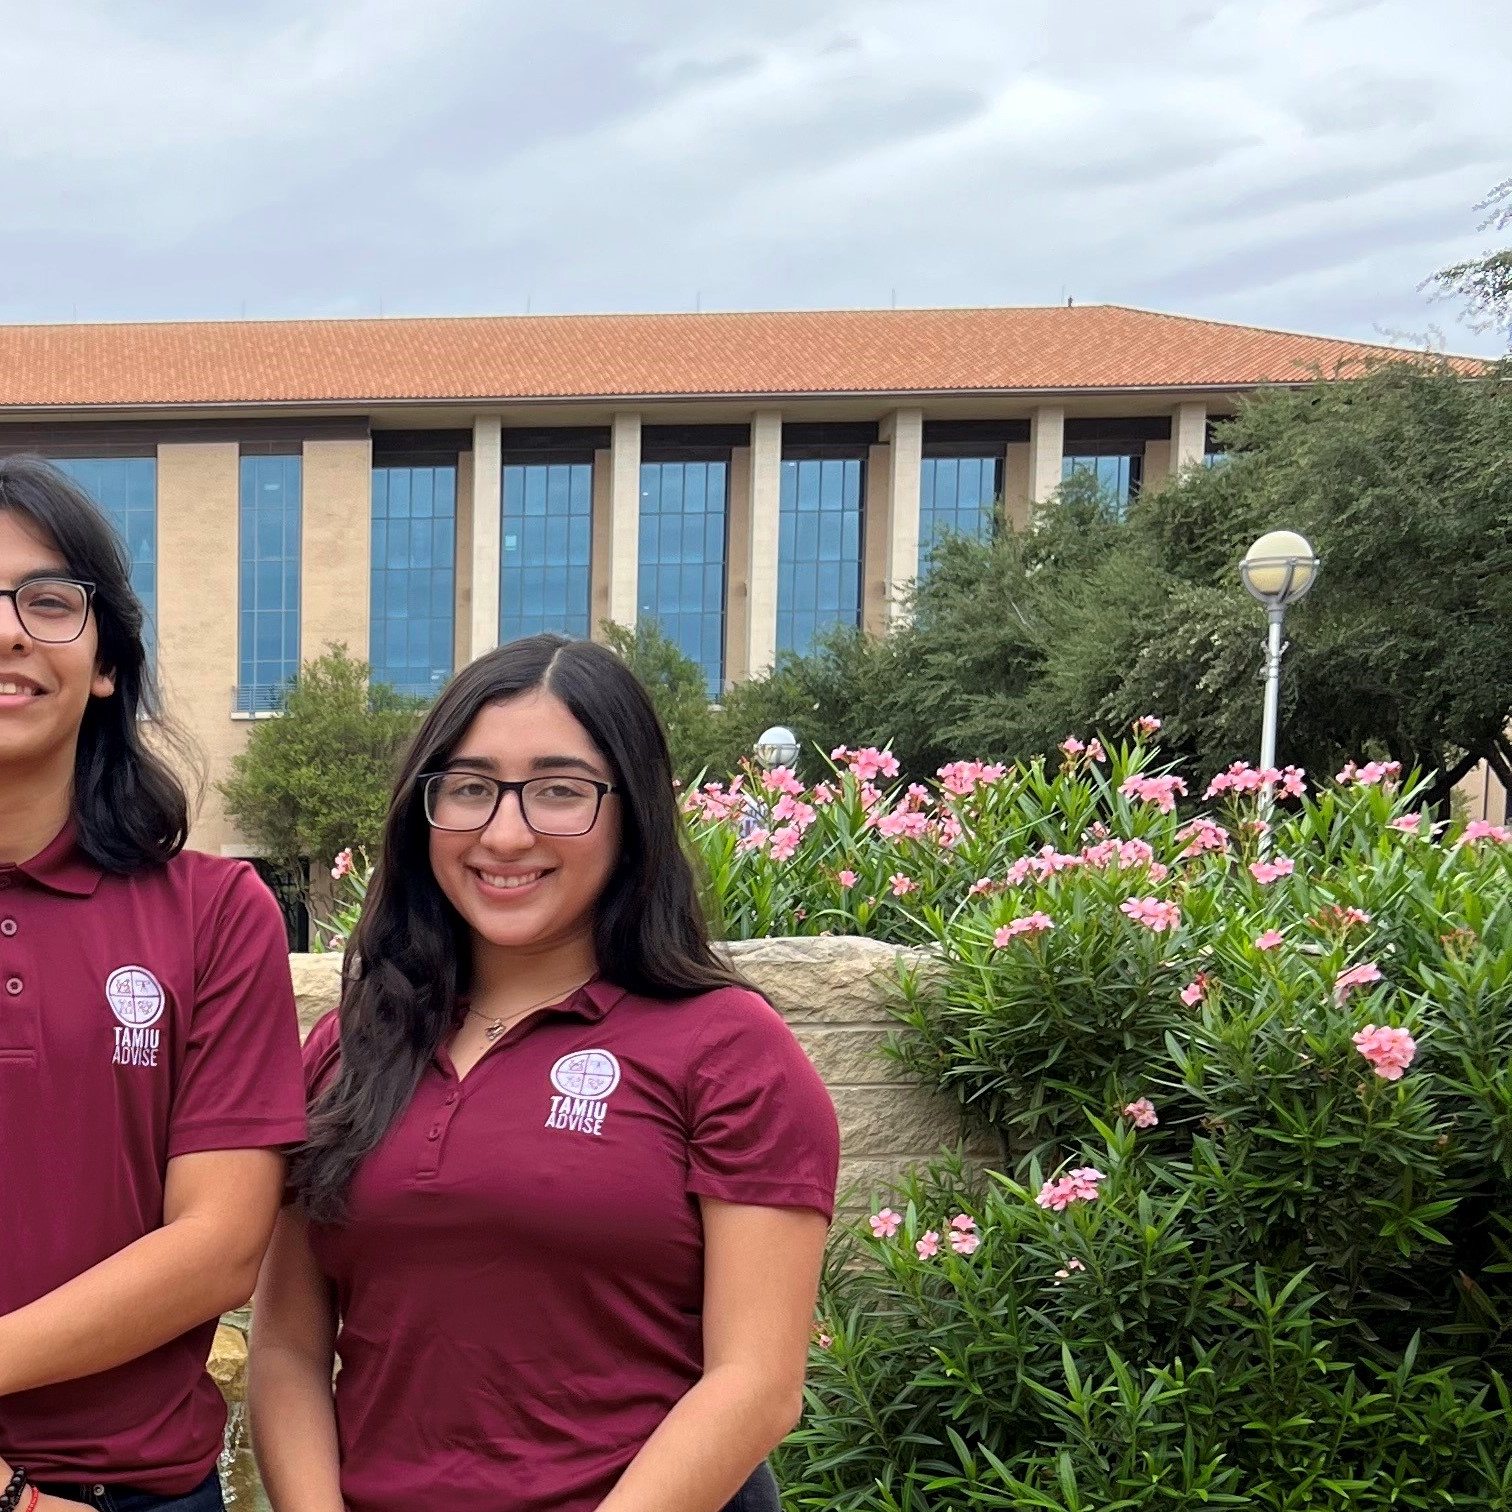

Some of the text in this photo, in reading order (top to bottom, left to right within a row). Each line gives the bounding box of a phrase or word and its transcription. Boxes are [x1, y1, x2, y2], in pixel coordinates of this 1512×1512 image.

[113, 1026, 159, 1048] TAMIU
[112, 1046, 159, 1067] ADVISE
[550, 1096, 608, 1119] TAMIU
[544, 1111, 603, 1135] ADVISE
